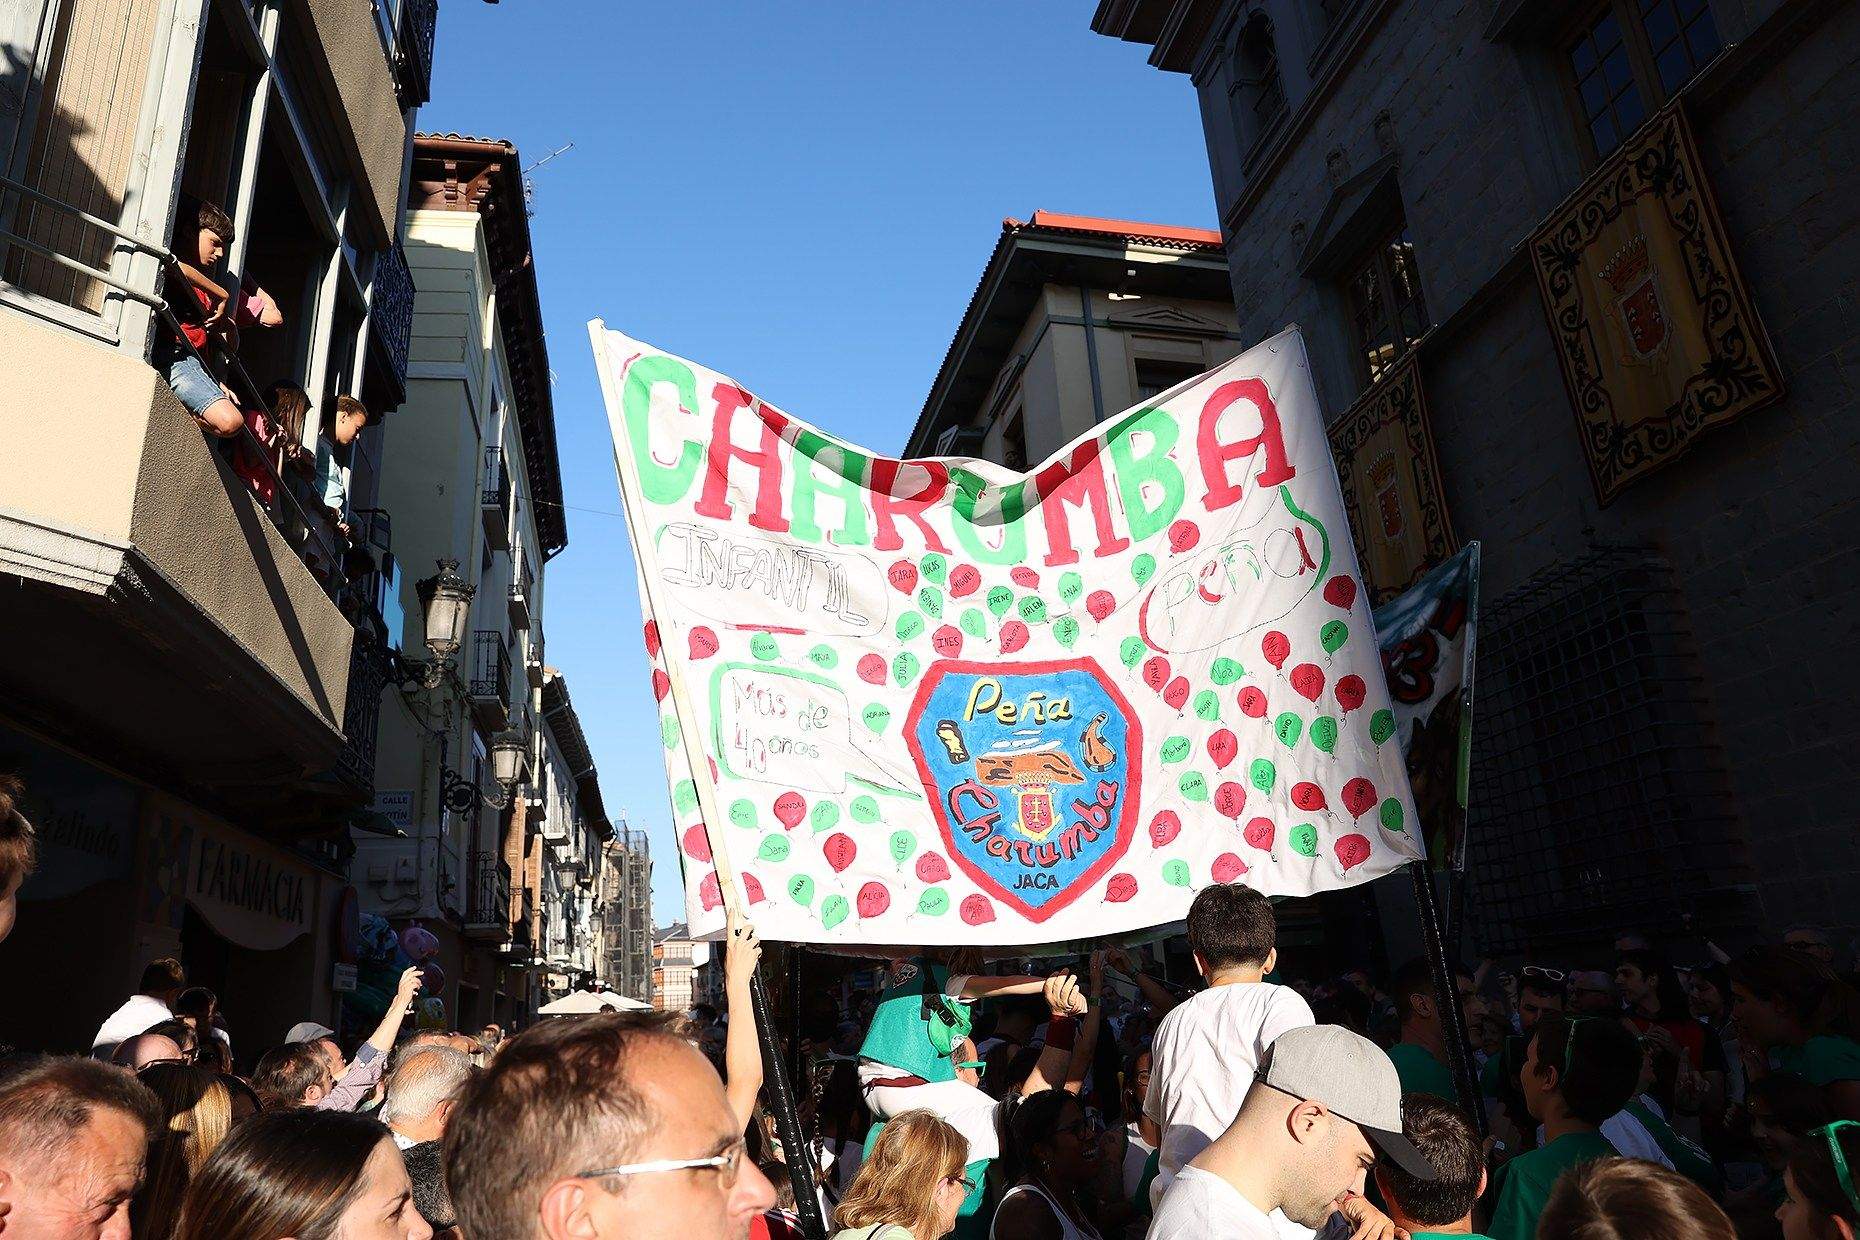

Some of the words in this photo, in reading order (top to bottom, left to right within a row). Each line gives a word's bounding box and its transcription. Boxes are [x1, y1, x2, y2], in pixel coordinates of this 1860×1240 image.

[623, 355, 1296, 566] CHARUMBA
[662, 523, 870, 626] INFANTIL
[963, 677, 1073, 726] Peña
[382, 796, 408, 805] CALLE
[948, 778, 1120, 869] Charumba
[196, 837, 304, 925] FARMACIA
[1013, 872, 1060, 890] JACA
